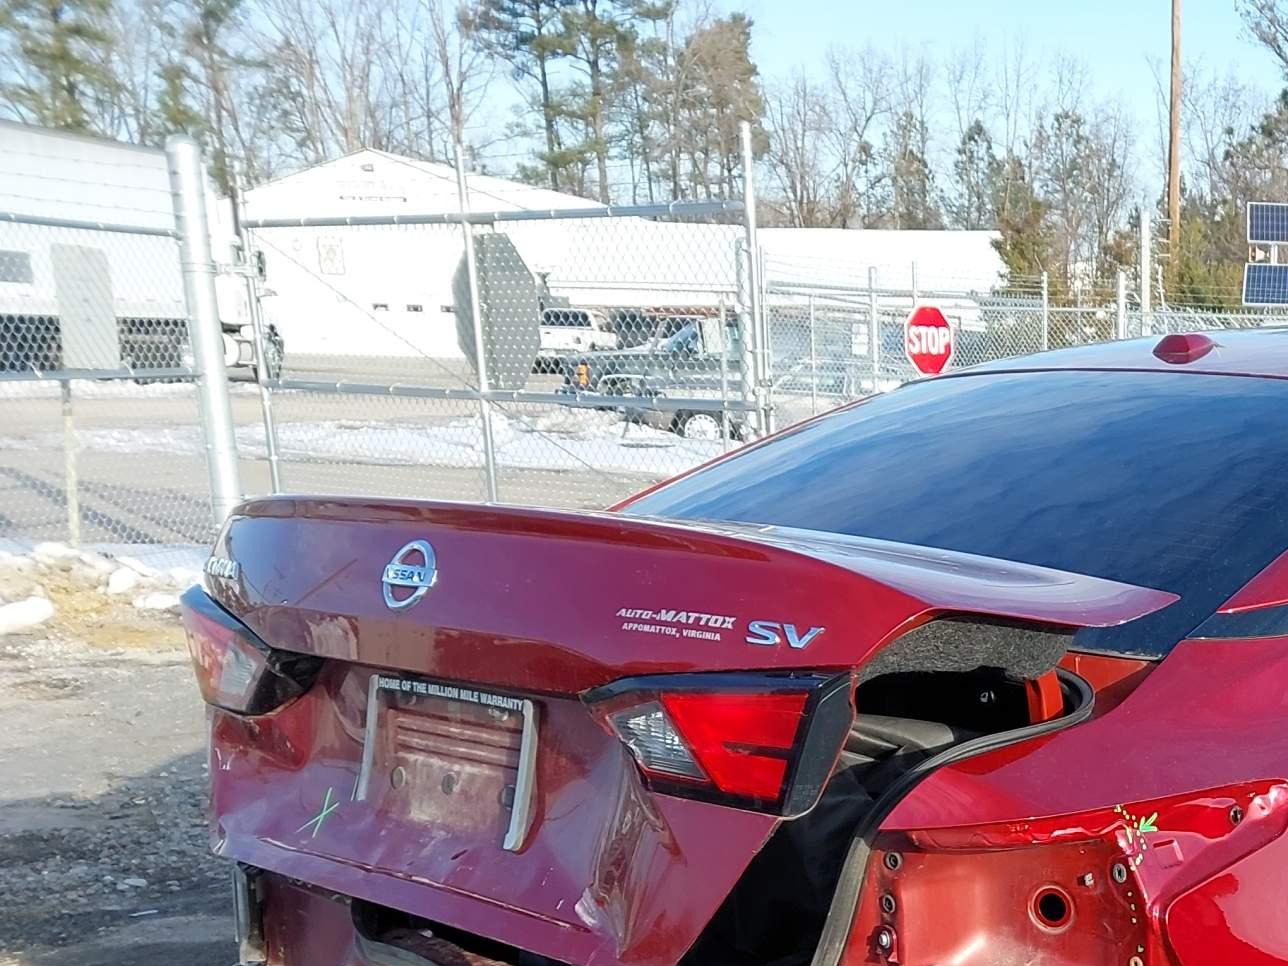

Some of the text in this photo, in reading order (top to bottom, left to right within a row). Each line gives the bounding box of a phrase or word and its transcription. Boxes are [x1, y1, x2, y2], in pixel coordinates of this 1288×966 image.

[909, 325, 950, 355] STOP
[622, 622, 721, 642] APPOMATTOX, VIRGINIA
[745, 620, 826, 650] SV
[379, 677, 524, 710] HOME OF THE MILLION MILE WARRANTY
